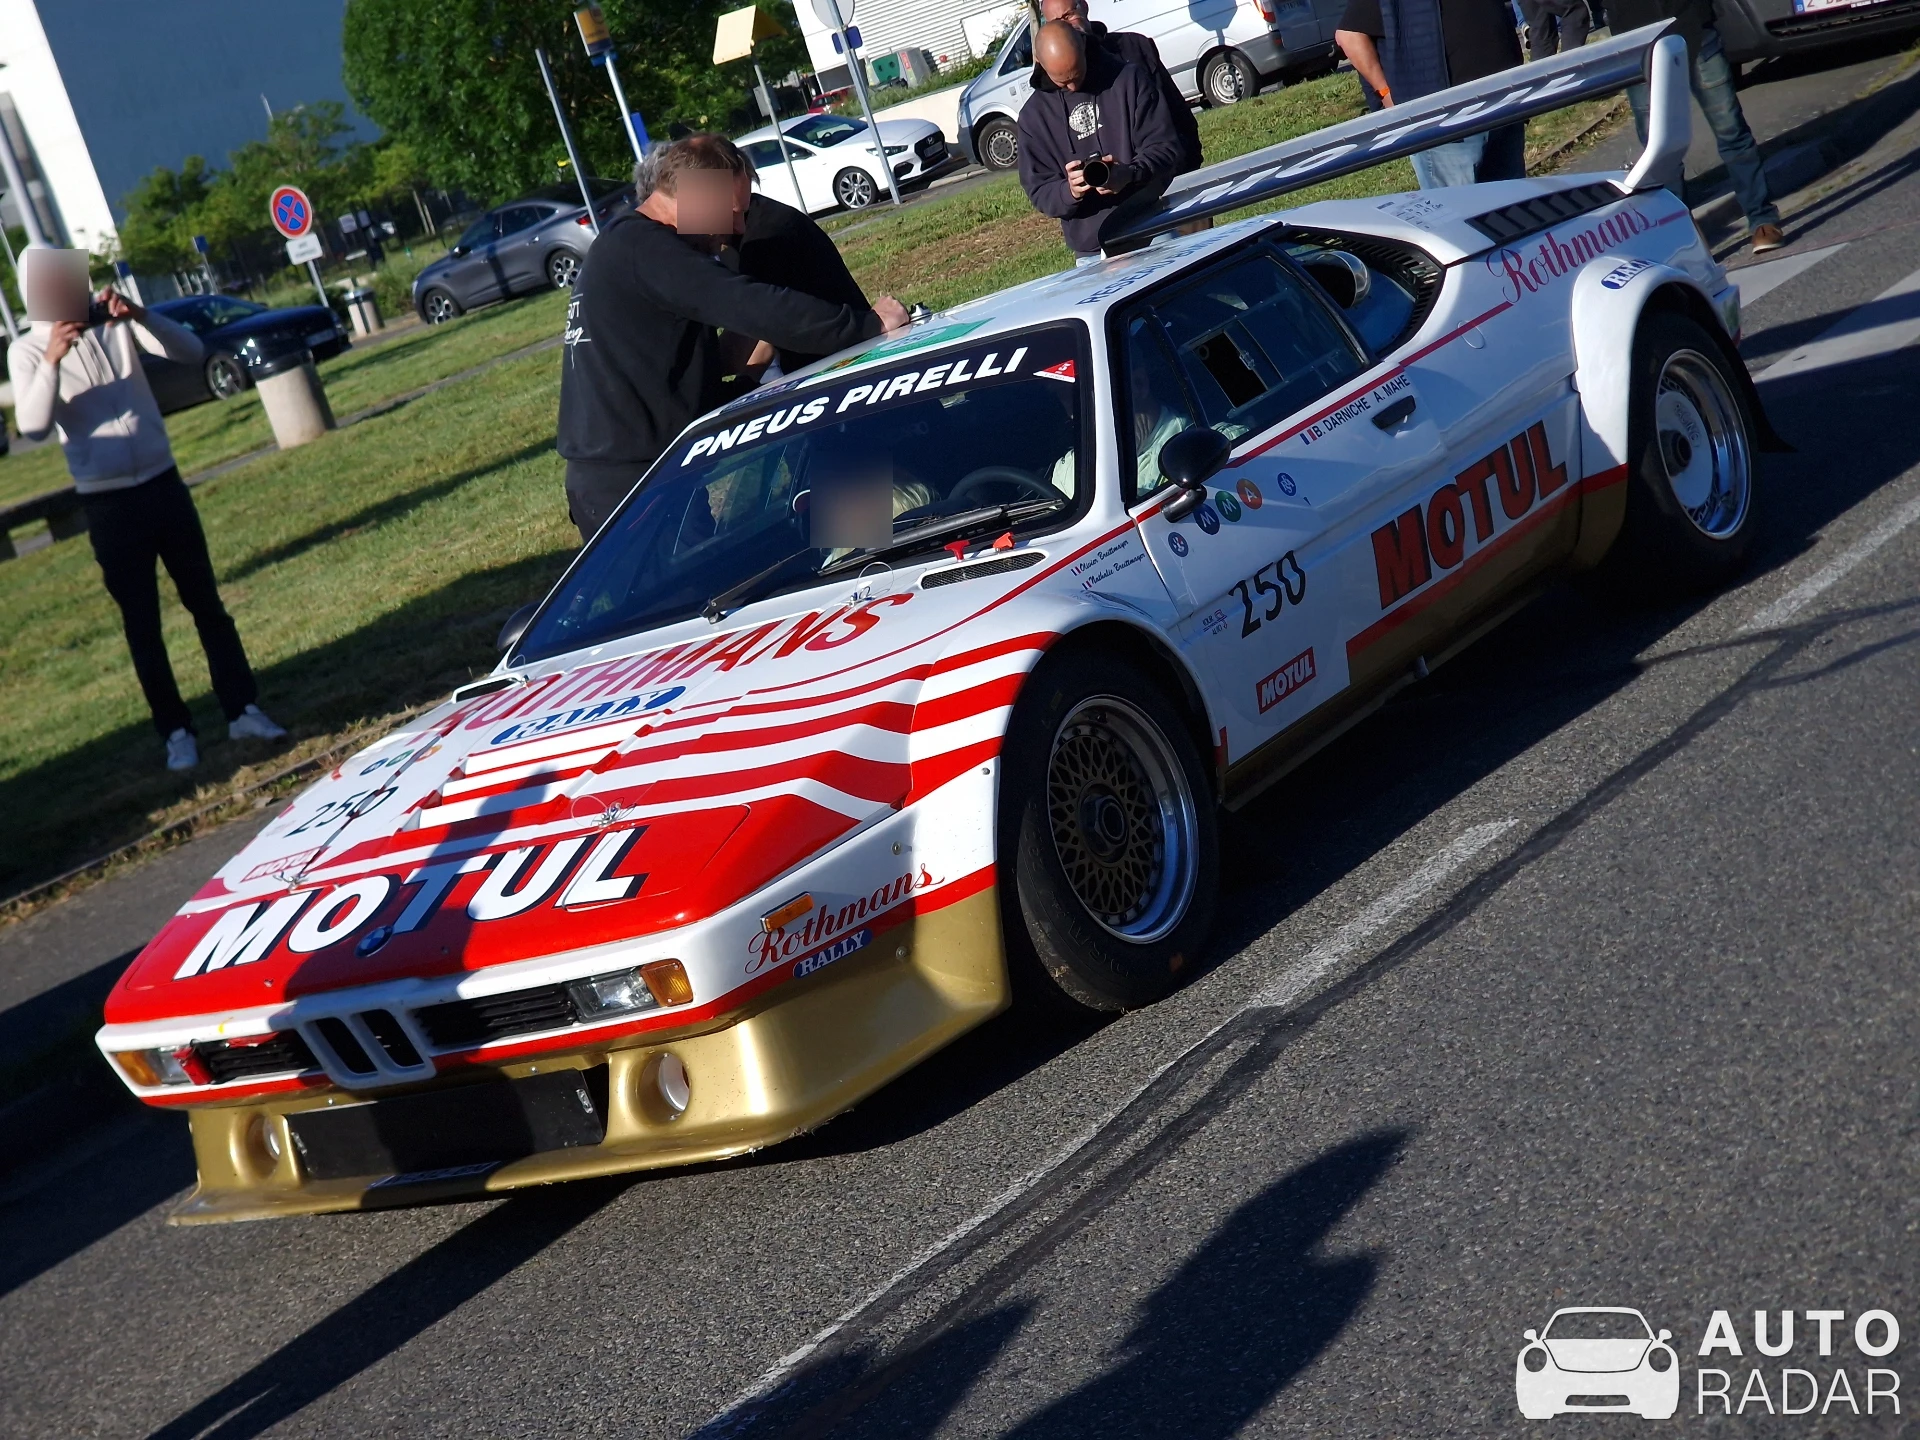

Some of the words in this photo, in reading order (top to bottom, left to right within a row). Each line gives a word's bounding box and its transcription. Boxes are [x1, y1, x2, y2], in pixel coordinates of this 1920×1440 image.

[1486, 203, 1658, 304] Rothmans
[681, 396, 830, 467] PNEUS
[835, 346, 1028, 414] PIRELLI
[1312, 425, 1326, 438] B.
[1323, 397, 1371, 431] DARNICHE
[1373, 390, 1386, 403] A.
[1382, 375, 1410, 396] MAHE
[1371, 419, 1568, 610] MOTUL
[1080, 558, 1099, 572] Olivier
[1088, 568, 1114, 584] Nathalie
[1228, 550, 1306, 639] 250
[403, 593, 914, 747] ROTHMANS
[1261, 654, 1313, 709] MOTUL
[501, 690, 667, 743] RALLY
[284, 786, 399, 839] 250
[173, 824, 650, 981] MOTUL
[745, 863, 945, 975] Rothmans
[800, 929, 866, 977] RALLY
